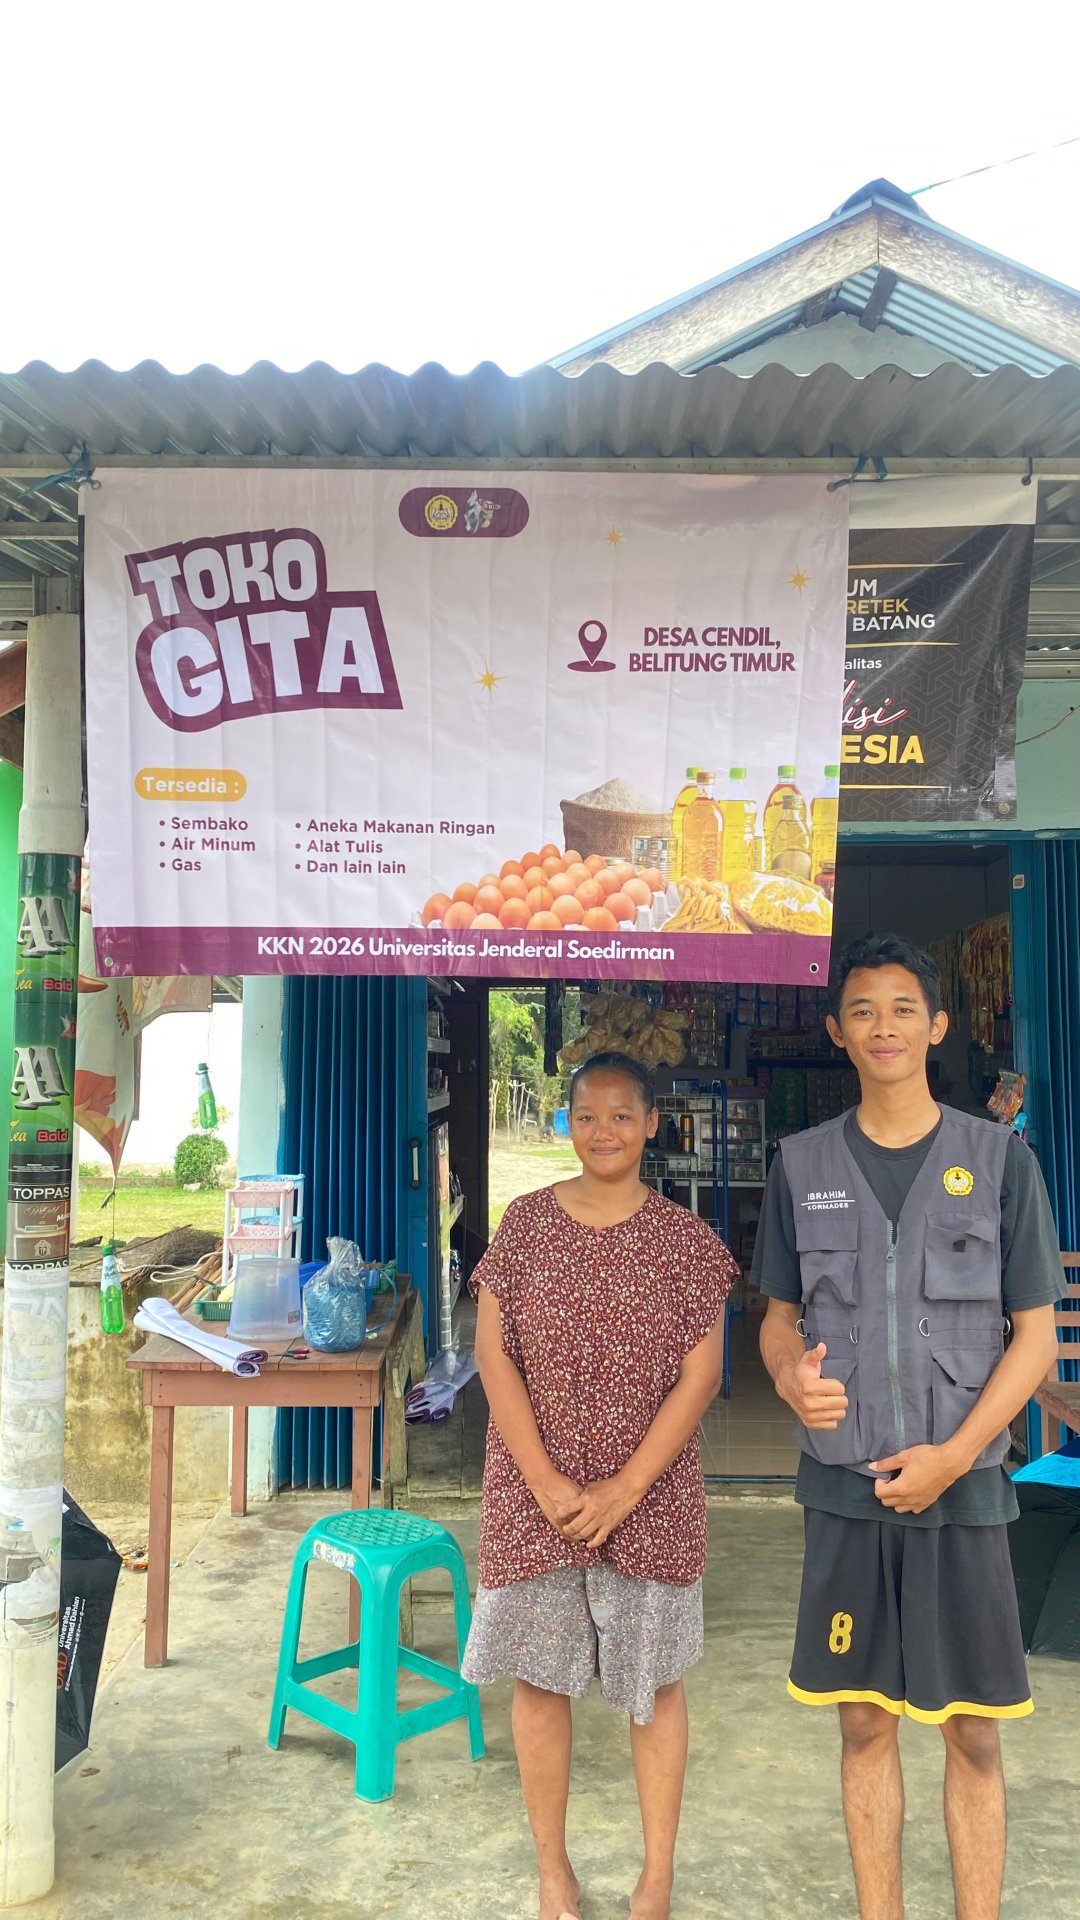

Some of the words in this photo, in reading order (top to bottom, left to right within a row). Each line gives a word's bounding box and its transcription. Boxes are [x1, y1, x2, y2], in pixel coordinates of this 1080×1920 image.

[136, 538, 318, 617] TOKO
[852, 613, 936, 632] BATANG
[643, 627, 698, 647] DESA
[701, 627, 781, 650] CENDIL,
[150, 606, 385, 717] GITA
[629, 653, 727, 672] BELITUNG
[730, 652, 796, 672] TIMUR
[142, 776, 228, 794] Tersedia
[171, 817, 249, 831] Sembako
[307, 819, 358, 834] Aneka
[363, 820, 434, 834] Makanan
[440, 821, 495, 836] Ringan
[171, 838, 196, 851] Air
[201, 838, 256, 852] Minum
[306, 839, 340, 853] Alat
[345, 840, 383, 854] Tulis
[171, 858, 202, 872] Gas
[306, 860, 338, 874] Dan
[344, 860, 373, 874] lain
[378, 861, 406, 875] lain
[257, 936, 304, 956] KKN
[309, 936, 365, 956] 2026
[369, 937, 476, 958] Universitas
[479, 938, 563, 959] Jenderal
[566, 940, 675, 961] Soedirman
[43, 978, 73, 992] Bold
[37, 1129, 69, 1143] Bold
[13, 1186, 70, 1200] TOPPAS
[807, 1190, 847, 1201] IBRAHIM
[807, 1202, 849, 1211] KORMADES
[70, 1596, 80, 1621] Dahlan
[59, 1606, 71, 1648] Universitas
[828, 1611, 853, 1655] 8
[65, 1622, 76, 1650] Ahmad
